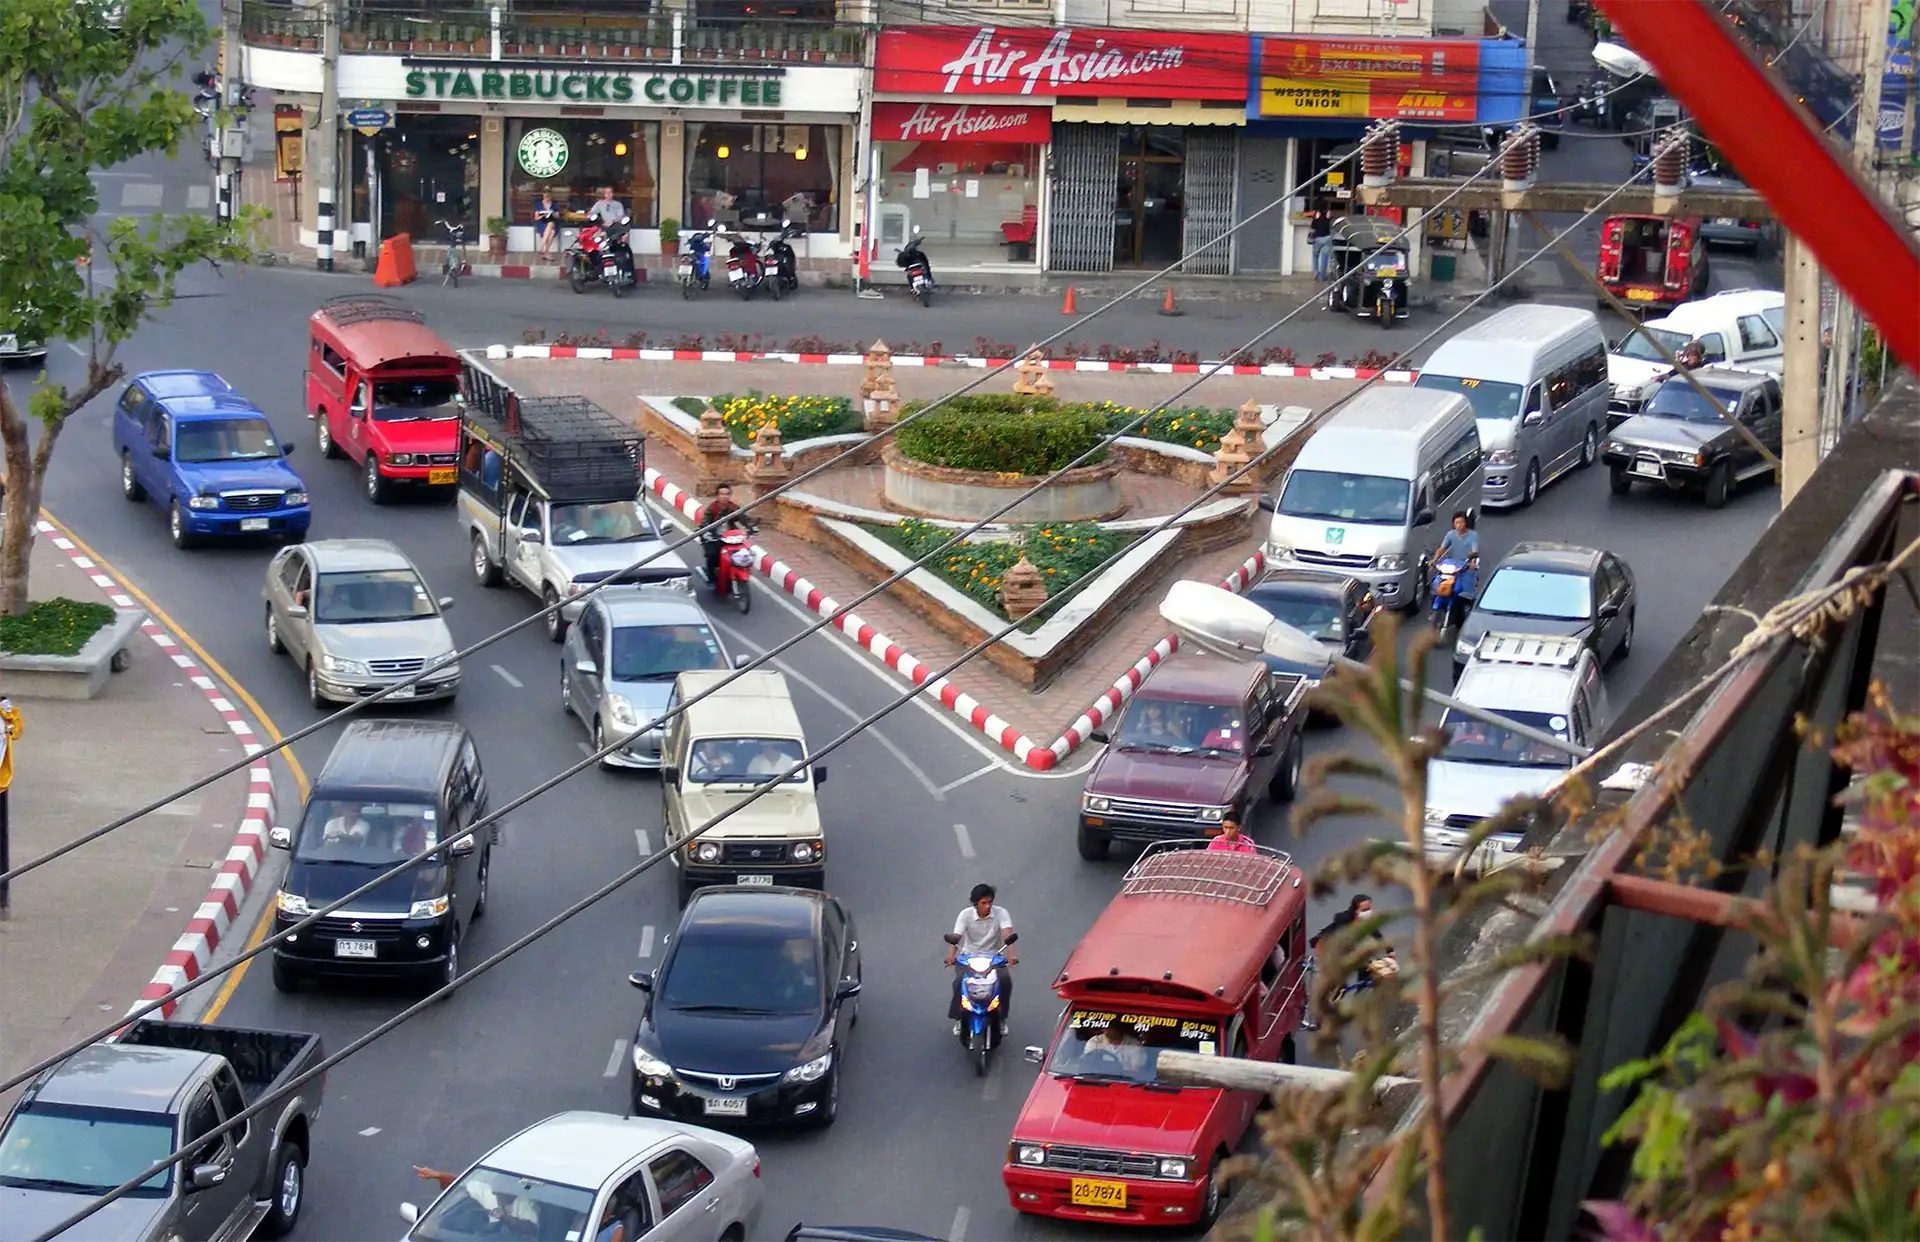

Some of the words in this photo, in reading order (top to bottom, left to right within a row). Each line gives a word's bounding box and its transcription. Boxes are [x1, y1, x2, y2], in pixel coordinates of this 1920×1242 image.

[406, 71, 634, 101] STARBUCKS
[644, 76, 781, 105] COFFEE
[1274, 87, 1341, 98] WESTERN
[1295, 98, 1340, 108] UNION
[1397, 89, 1448, 108] ATM
[354, 941, 374, 951] 7894
[1200, 1023, 1217, 1034] PUI
